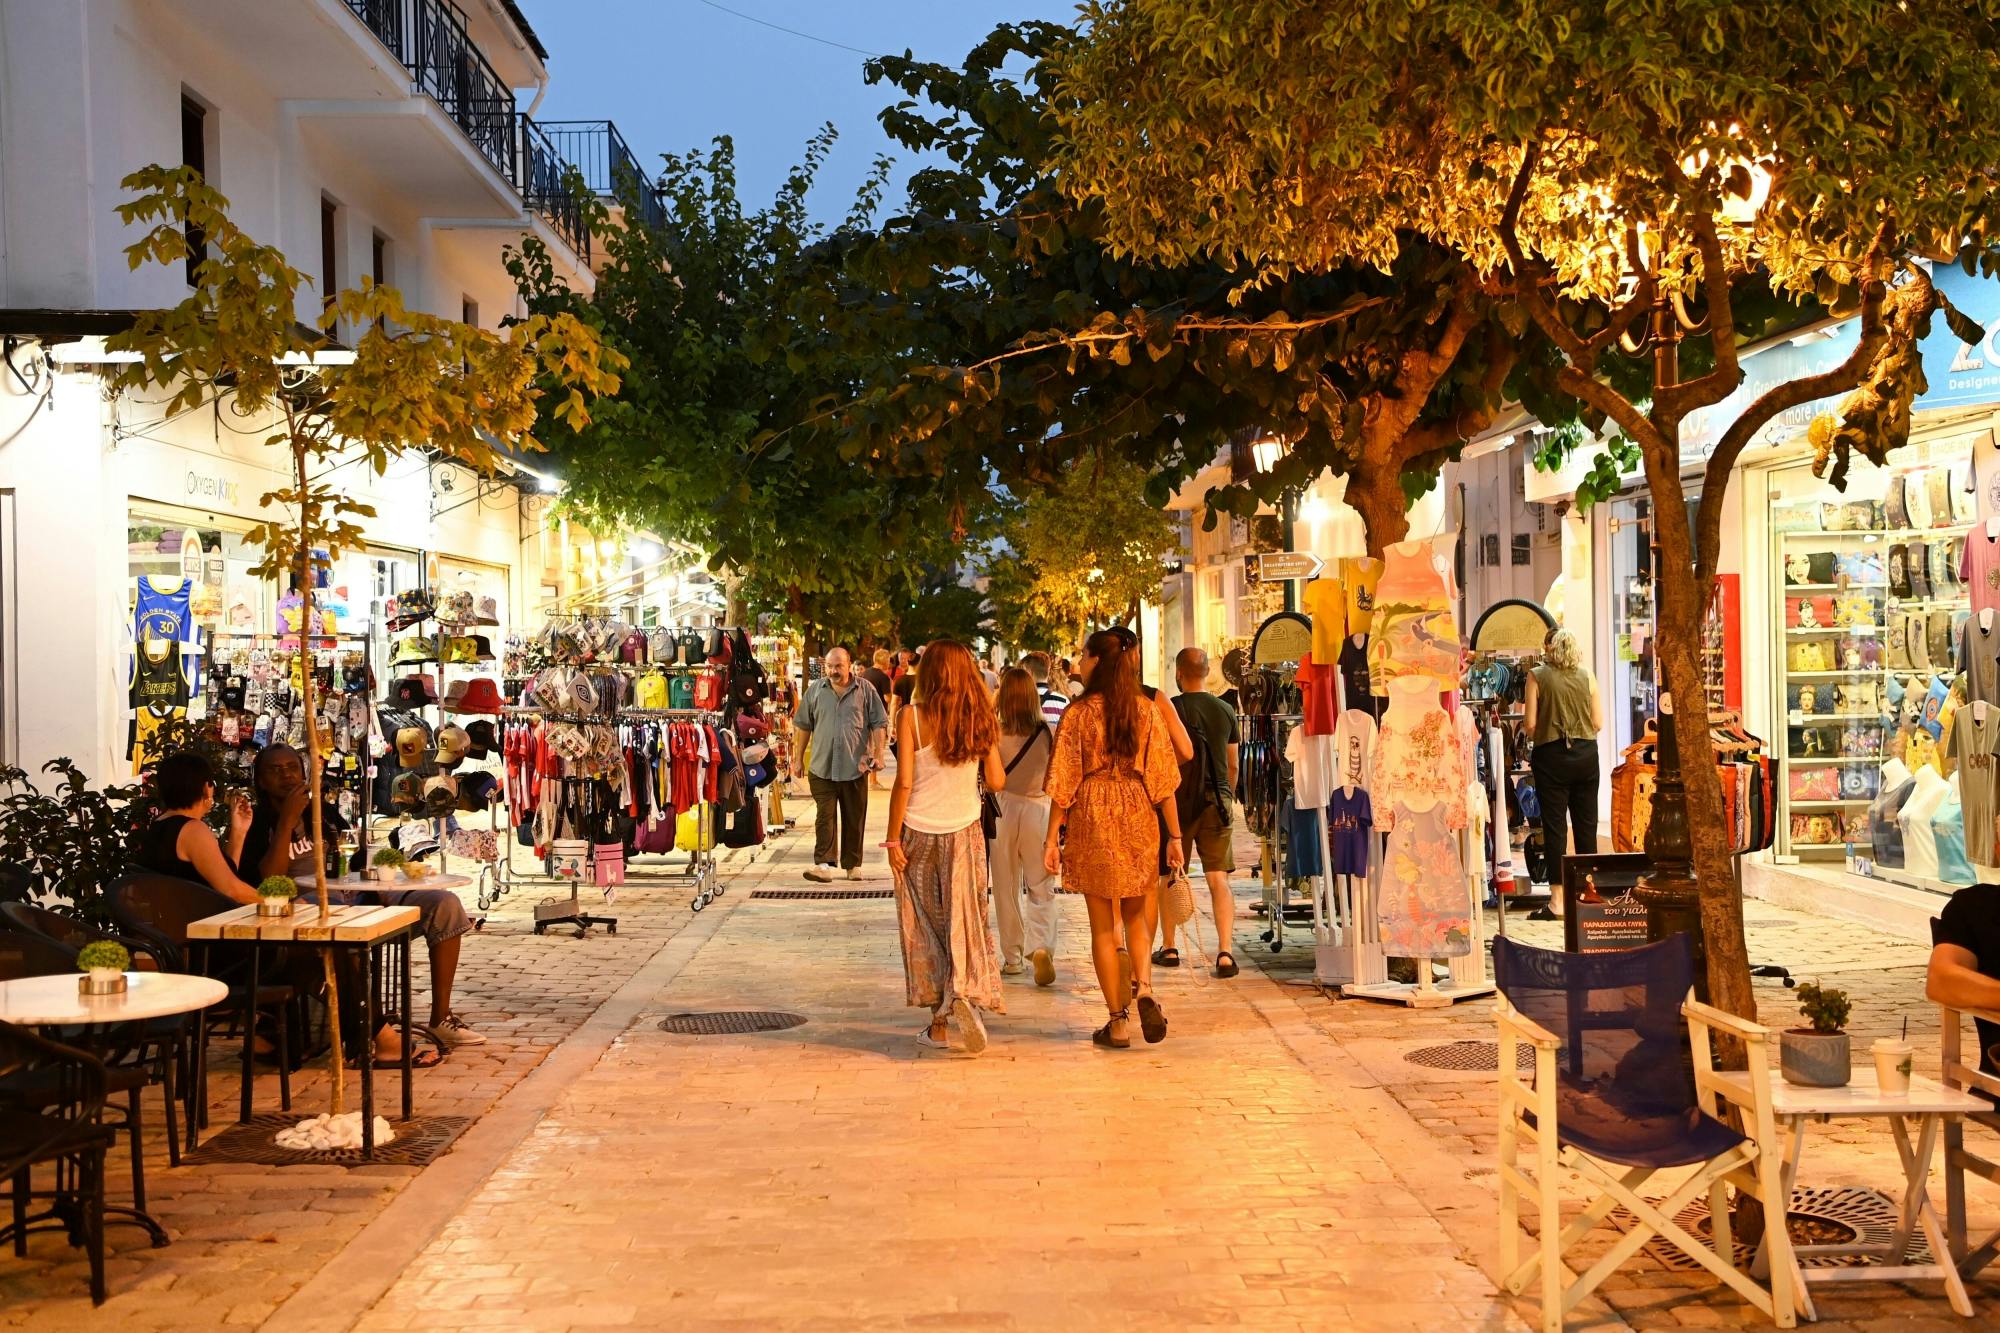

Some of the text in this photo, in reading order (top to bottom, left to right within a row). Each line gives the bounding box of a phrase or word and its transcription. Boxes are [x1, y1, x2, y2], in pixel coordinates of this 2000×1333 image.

[1949, 377, 2000, 390] Designe
[1785, 404, 1811, 424] more
[140, 607, 183, 624] GOLDEN STATE
[159, 620, 175, 634] 30
[1604, 908, 1620, 916] του
